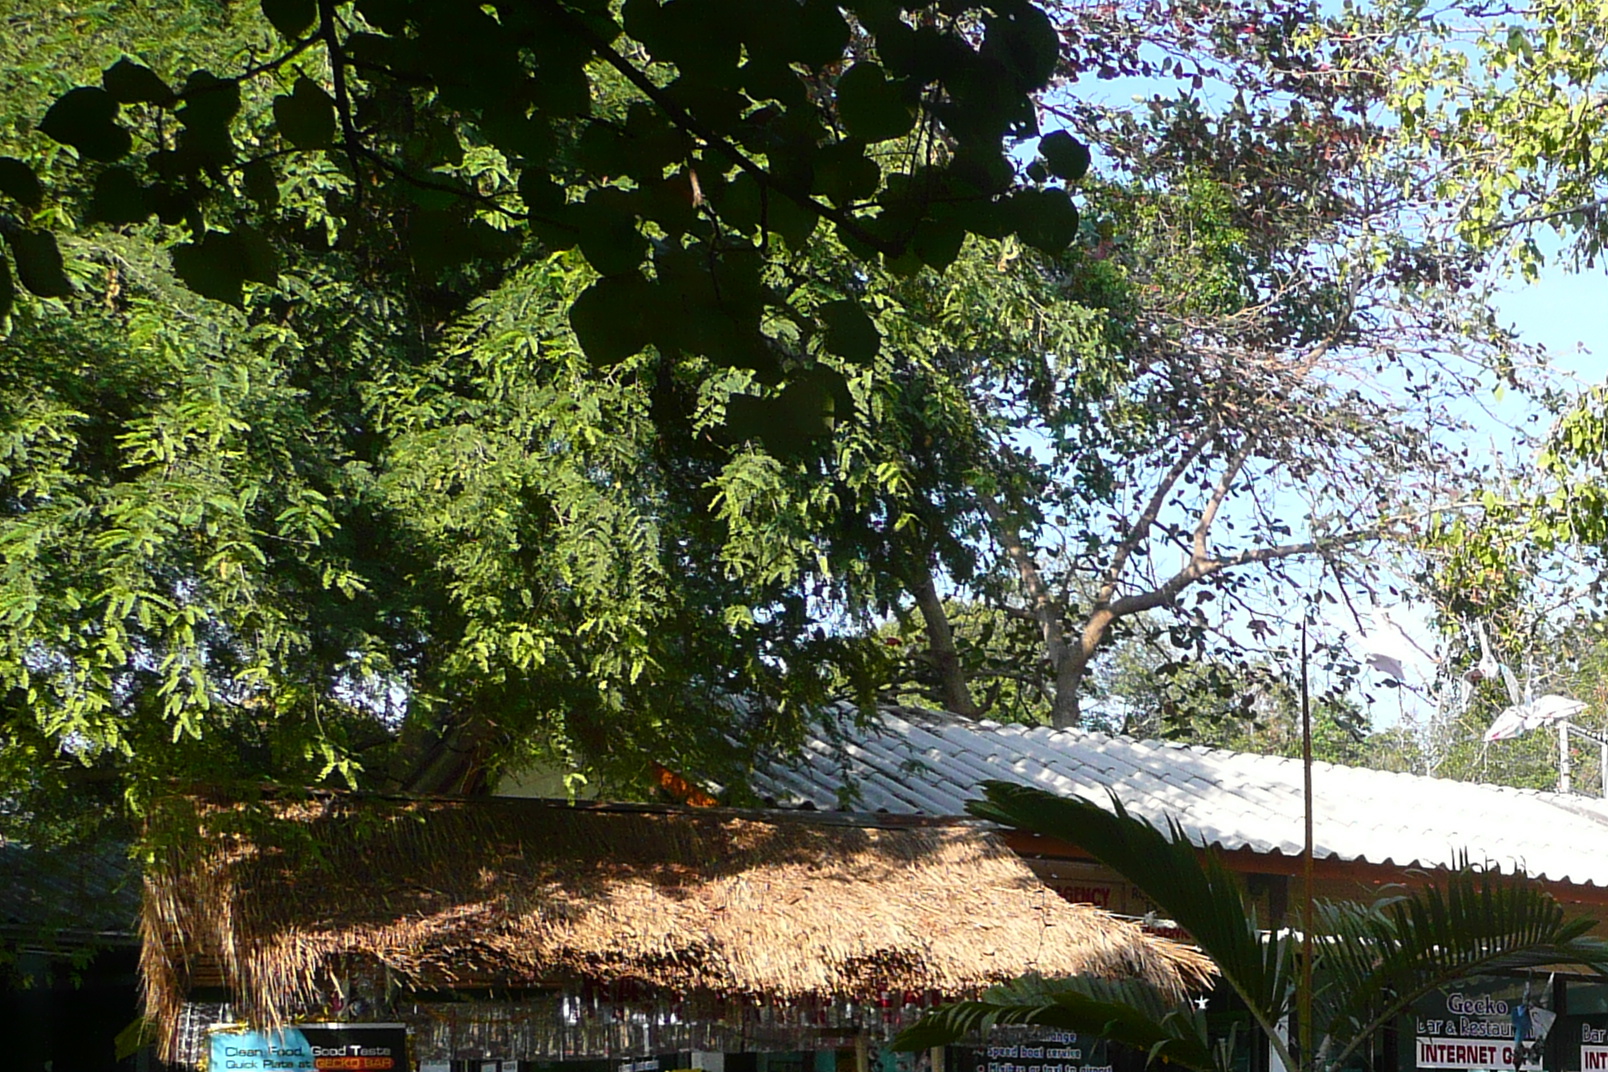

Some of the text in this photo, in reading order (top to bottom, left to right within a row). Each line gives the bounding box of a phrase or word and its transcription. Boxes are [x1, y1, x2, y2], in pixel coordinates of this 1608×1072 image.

[1447, 993, 1508, 1016] Gecko
[1446, 1021, 1457, 1035] &
[1582, 1023, 1606, 1043] Bar
[225, 1046, 263, 1057] Clean
[310, 1045, 347, 1056] Good
[350, 1044, 392, 1056] Taste
[988, 1046, 1081, 1060] Speed boat service
[1421, 1044, 1496, 1065] INTERNET
[225, 1058, 393, 1069] Quick Plate at GECKO BAR
